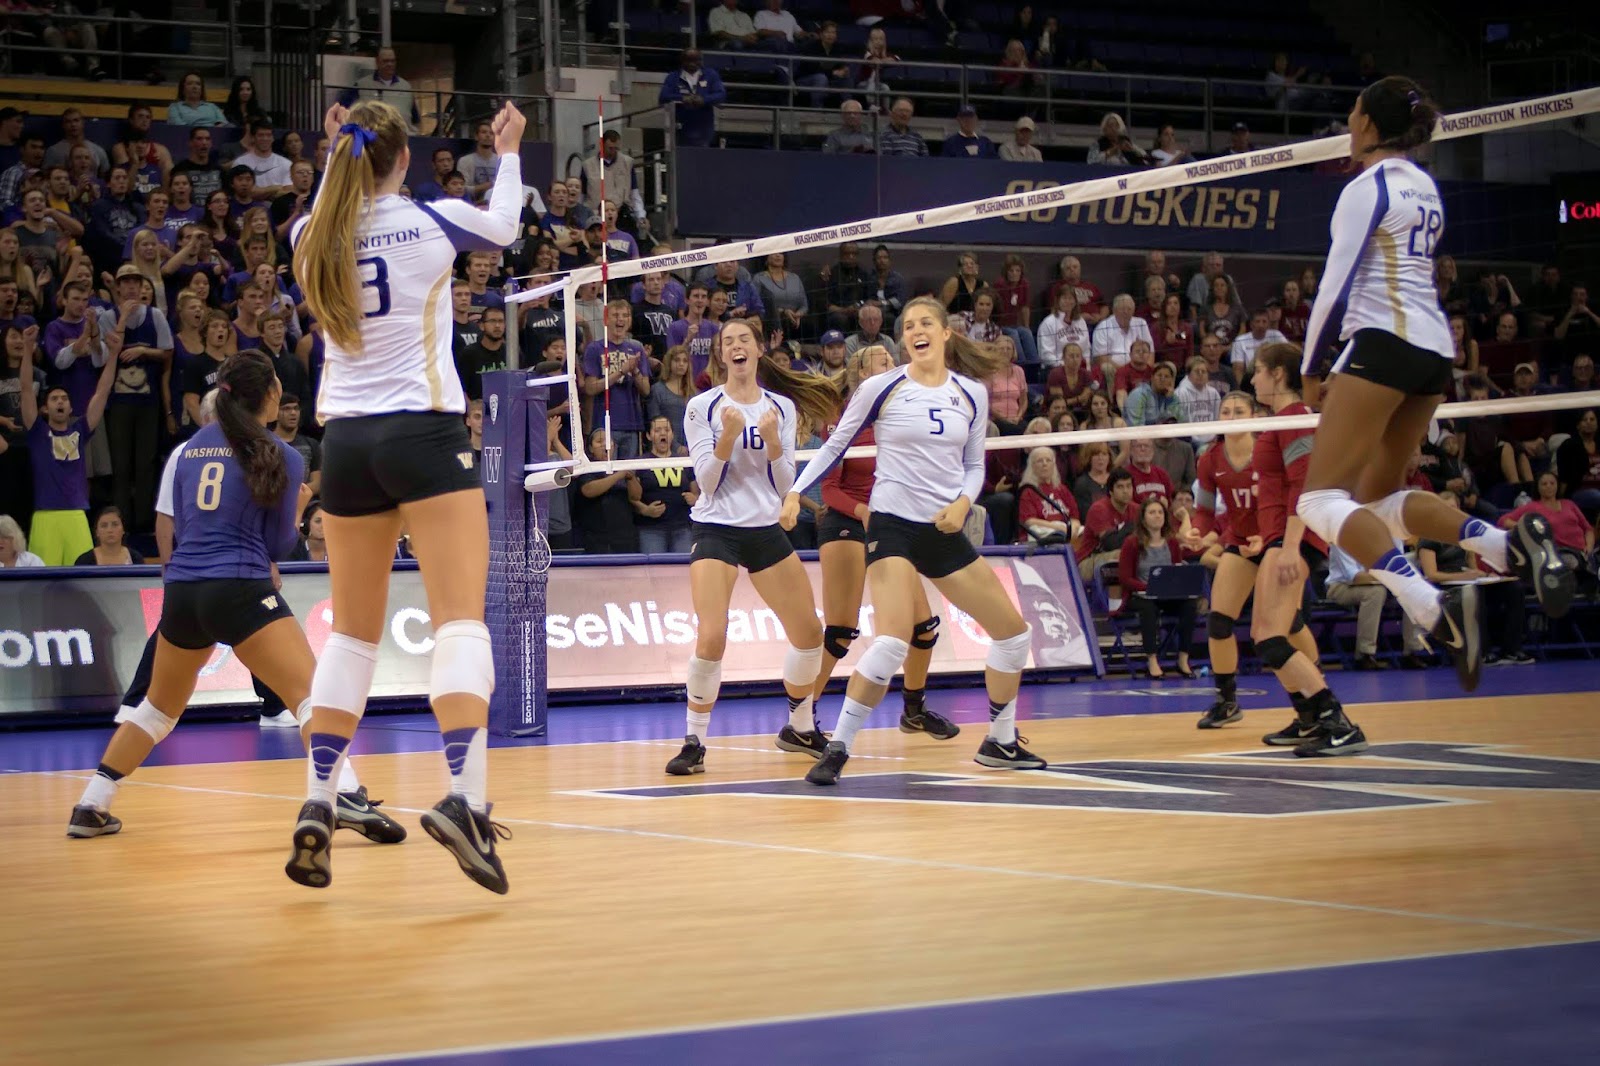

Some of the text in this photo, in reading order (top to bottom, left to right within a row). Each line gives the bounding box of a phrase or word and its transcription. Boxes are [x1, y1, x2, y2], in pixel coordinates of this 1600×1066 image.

[1441, 97, 1574, 133] WASHINGTON HUSKIES
[1185, 149, 1294, 178] WASHINGTON HUSKIES
[1117, 178, 1128, 190] W
[974, 190, 1065, 215] WASHINGTON HUSKIES
[916, 213, 925, 225] W
[793, 222, 872, 246] WASHINGTON HUSKIES
[1408, 205, 1442, 258] 28
[640, 251, 708, 270] WASHINGTON HUSKIES
[746, 243, 754, 254] W
[644, 311, 674, 336] W
[950, 396, 960, 407] W
[928, 408, 944, 435] 5
[742, 425, 764, 450] 16
[457, 452, 474, 470] W
[484, 446, 502, 483] W
[196, 461, 225, 511] 8
[650, 466, 684, 488] W
[1231, 488, 1251, 508] 17
[261, 595, 279, 611] W
